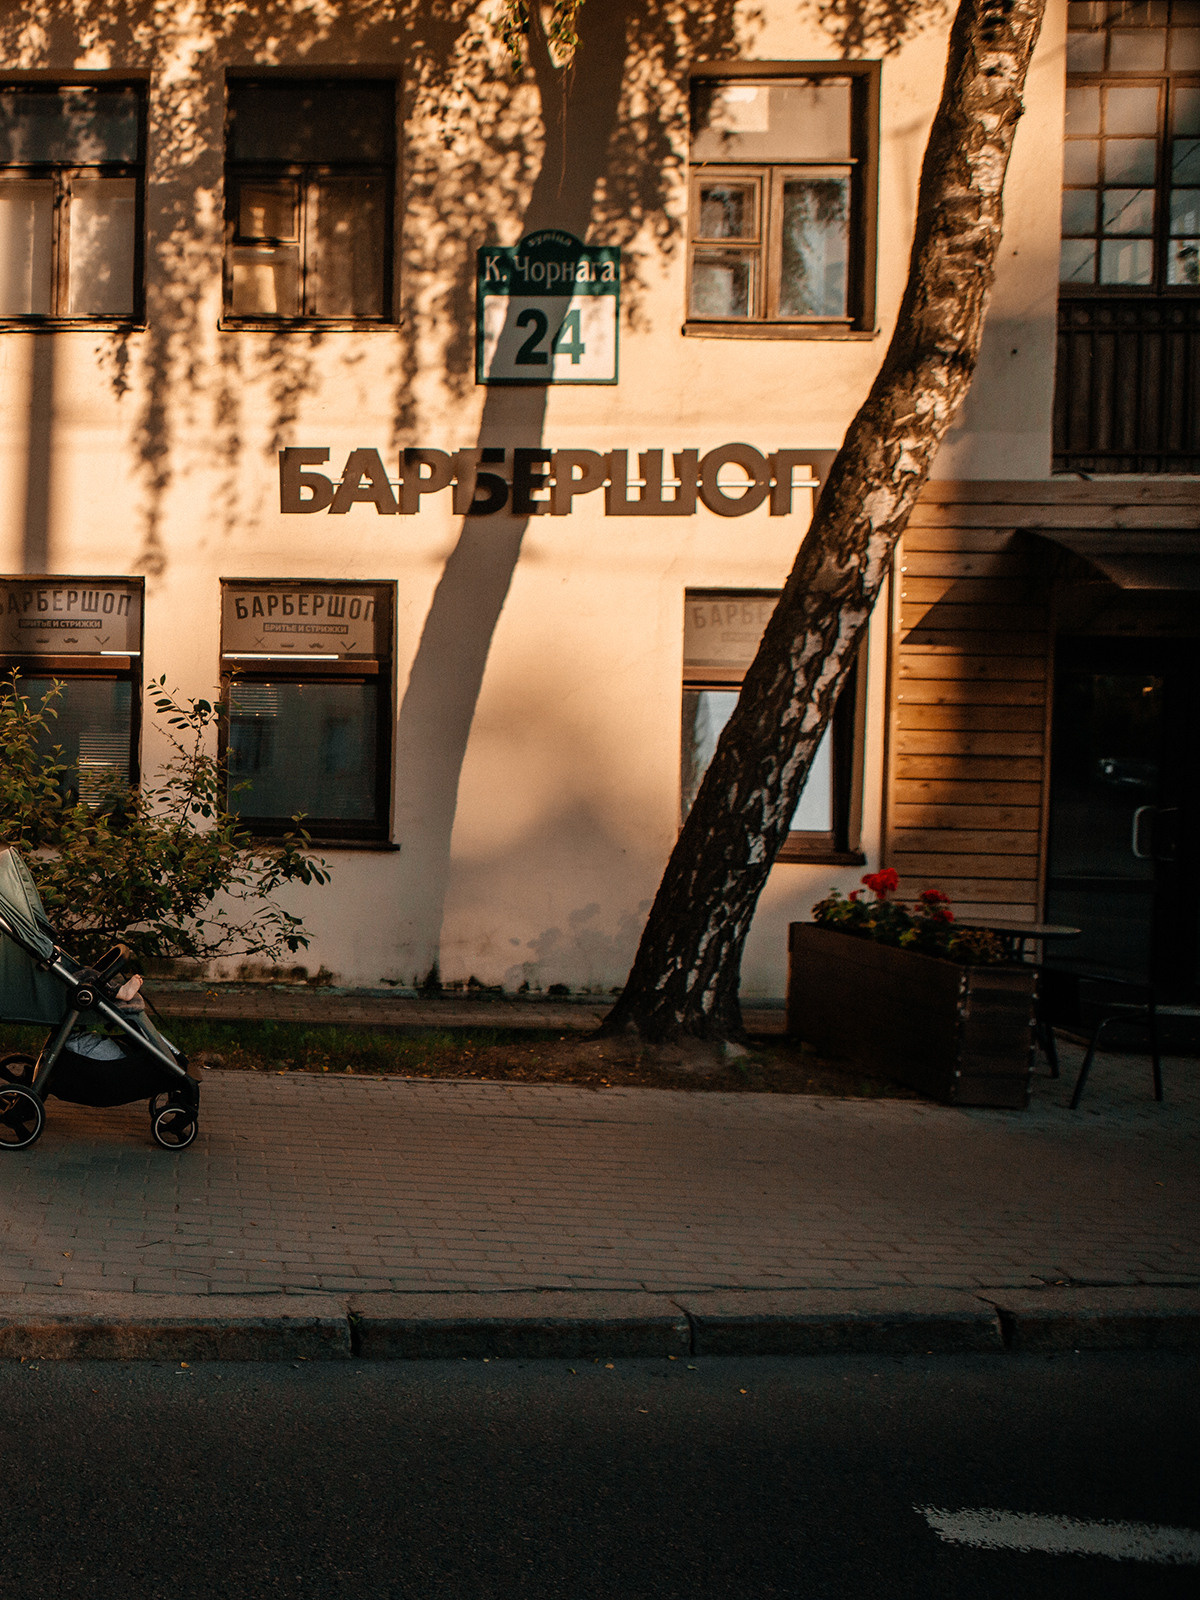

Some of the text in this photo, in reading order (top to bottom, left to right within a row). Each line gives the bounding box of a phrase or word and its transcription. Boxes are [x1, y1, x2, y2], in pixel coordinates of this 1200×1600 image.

[484, 255, 617, 290] К. Чорнага
[514, 308, 586, 365] 24
[279, 442, 837, 516] БАРБЕРШОП
